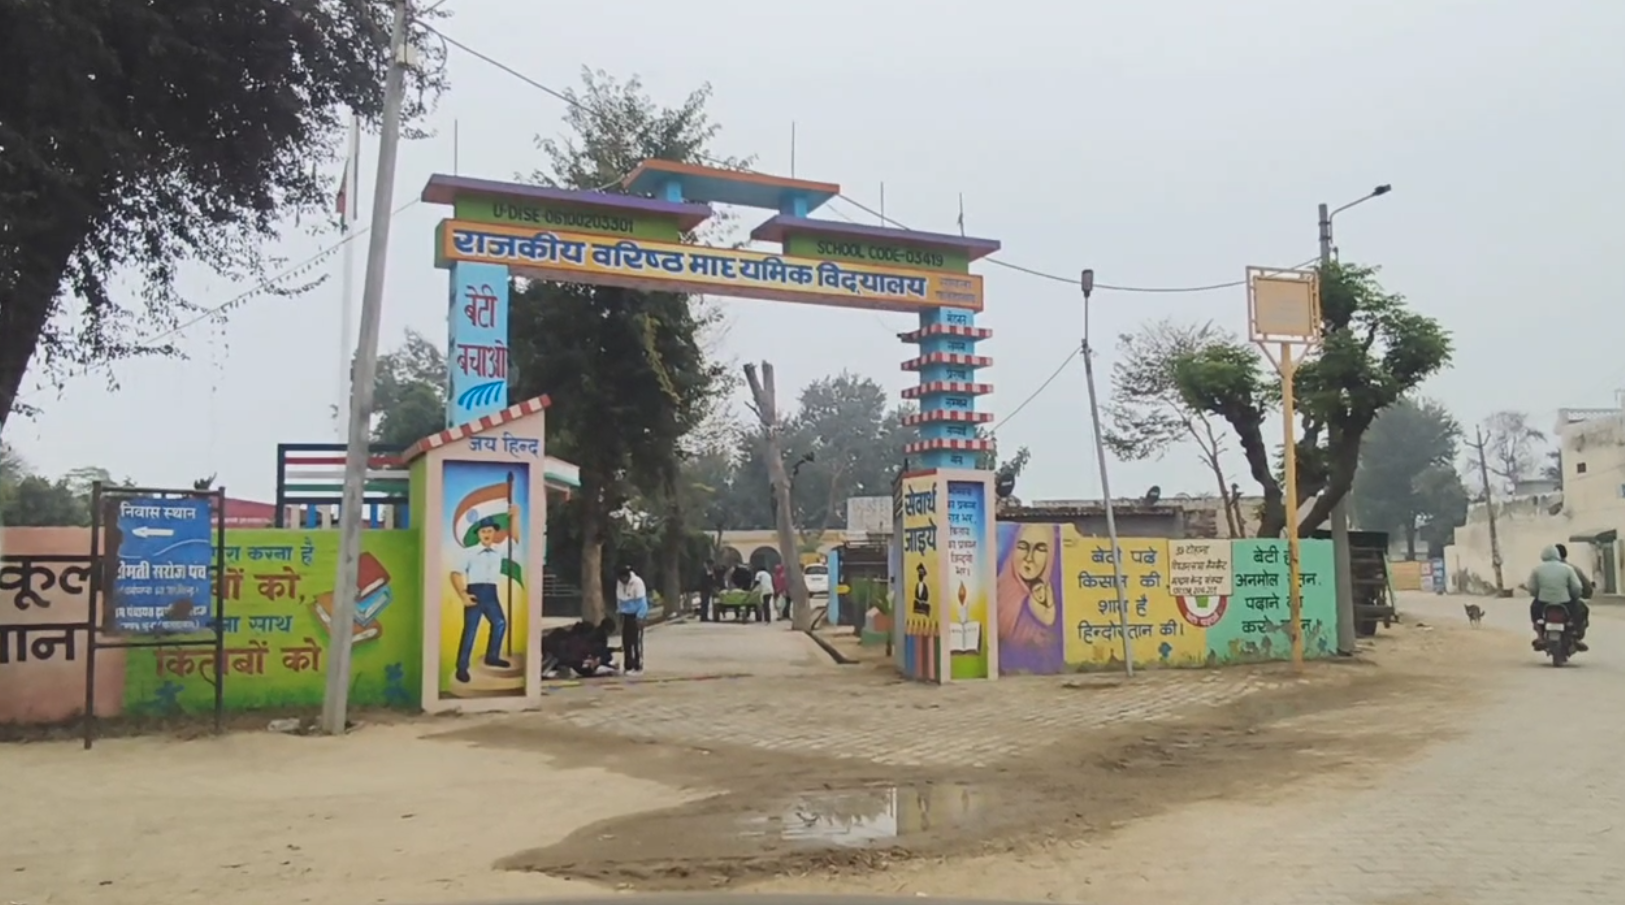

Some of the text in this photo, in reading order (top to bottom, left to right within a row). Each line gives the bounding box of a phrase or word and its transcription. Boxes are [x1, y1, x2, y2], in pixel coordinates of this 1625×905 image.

[452, 229, 587, 265] राजकीय
[591, 240, 686, 273] वरिष्ठ
[816, 239, 865, 259] SCHOOL
[464, 284, 497, 328] बेटी
[456, 340, 510, 379] बचाओ
[469, 432, 539, 458] जय हिन्द
[120, 500, 196, 519] निवास स्थान
[904, 482, 937, 516] सेवार्थ
[904, 518, 937, 557] जाइये
[247, 546, 292, 561] करना
[300, 536, 314, 566] है
[1253, 546, 1279, 563] बेटी
[1140, 570, 1161, 588] की
[1235, 570, 1279, 588] अनमोल
[1136, 595, 1148, 617] है
[249, 616, 293, 632] साथ
[281, 638, 322, 672] को
